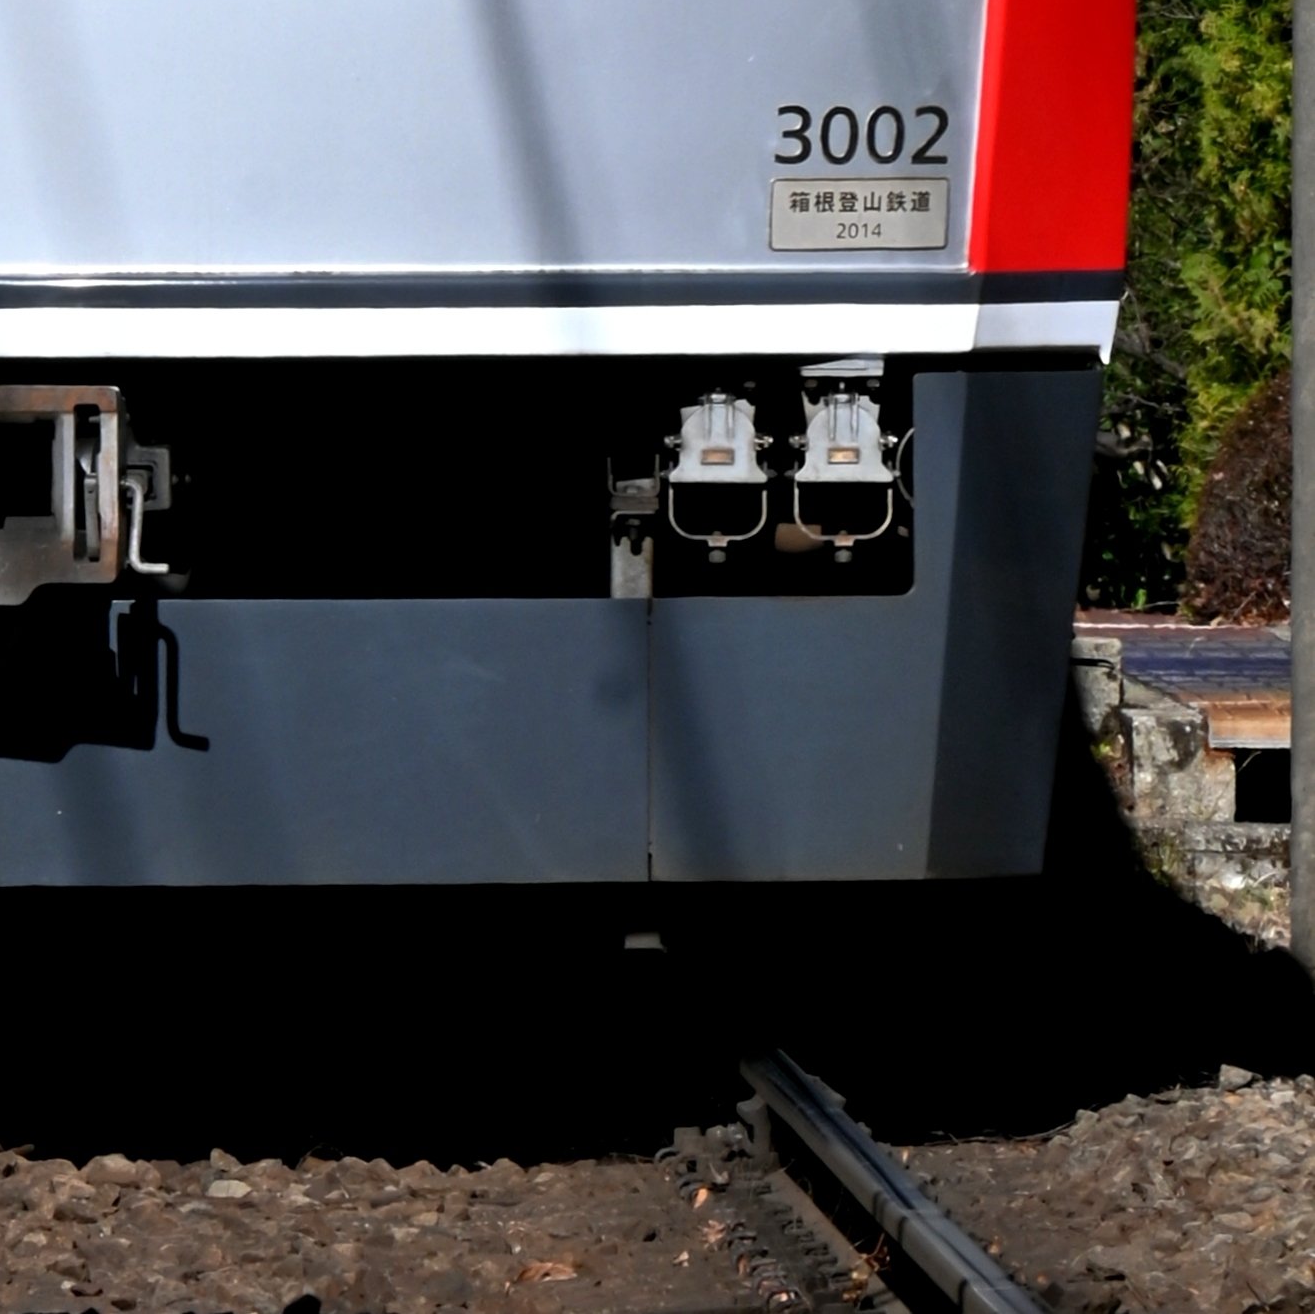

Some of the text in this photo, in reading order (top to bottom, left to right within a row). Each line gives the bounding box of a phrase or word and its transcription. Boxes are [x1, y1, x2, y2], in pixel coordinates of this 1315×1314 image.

[774, 105, 949, 165] 3002
[789, 191, 931, 213] 箱根登山鉄道
[836, 223, 882, 239] 2014
